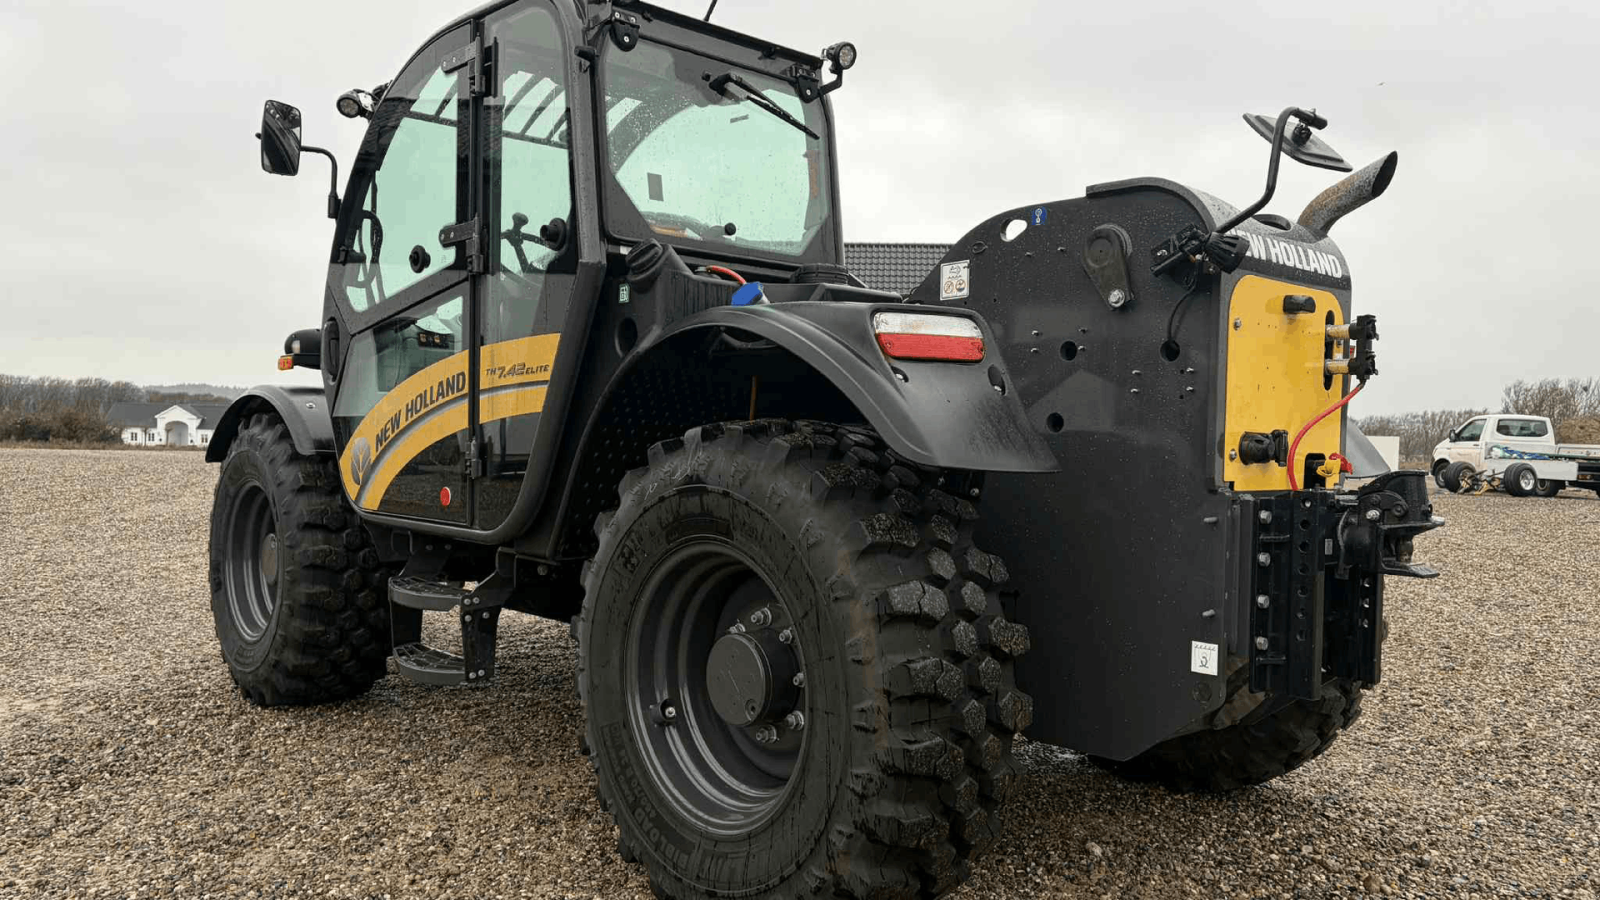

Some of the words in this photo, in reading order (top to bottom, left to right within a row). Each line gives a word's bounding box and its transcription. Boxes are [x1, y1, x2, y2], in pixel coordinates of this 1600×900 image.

[1268, 237, 1342, 278] HOLLAND
[486, 367, 497, 376] TH
[498, 362, 526, 379] 7.42
[525, 364, 550, 375] ELITE
[375, 409, 401, 453] NEW
[405, 371, 466, 420] HOLLAND
